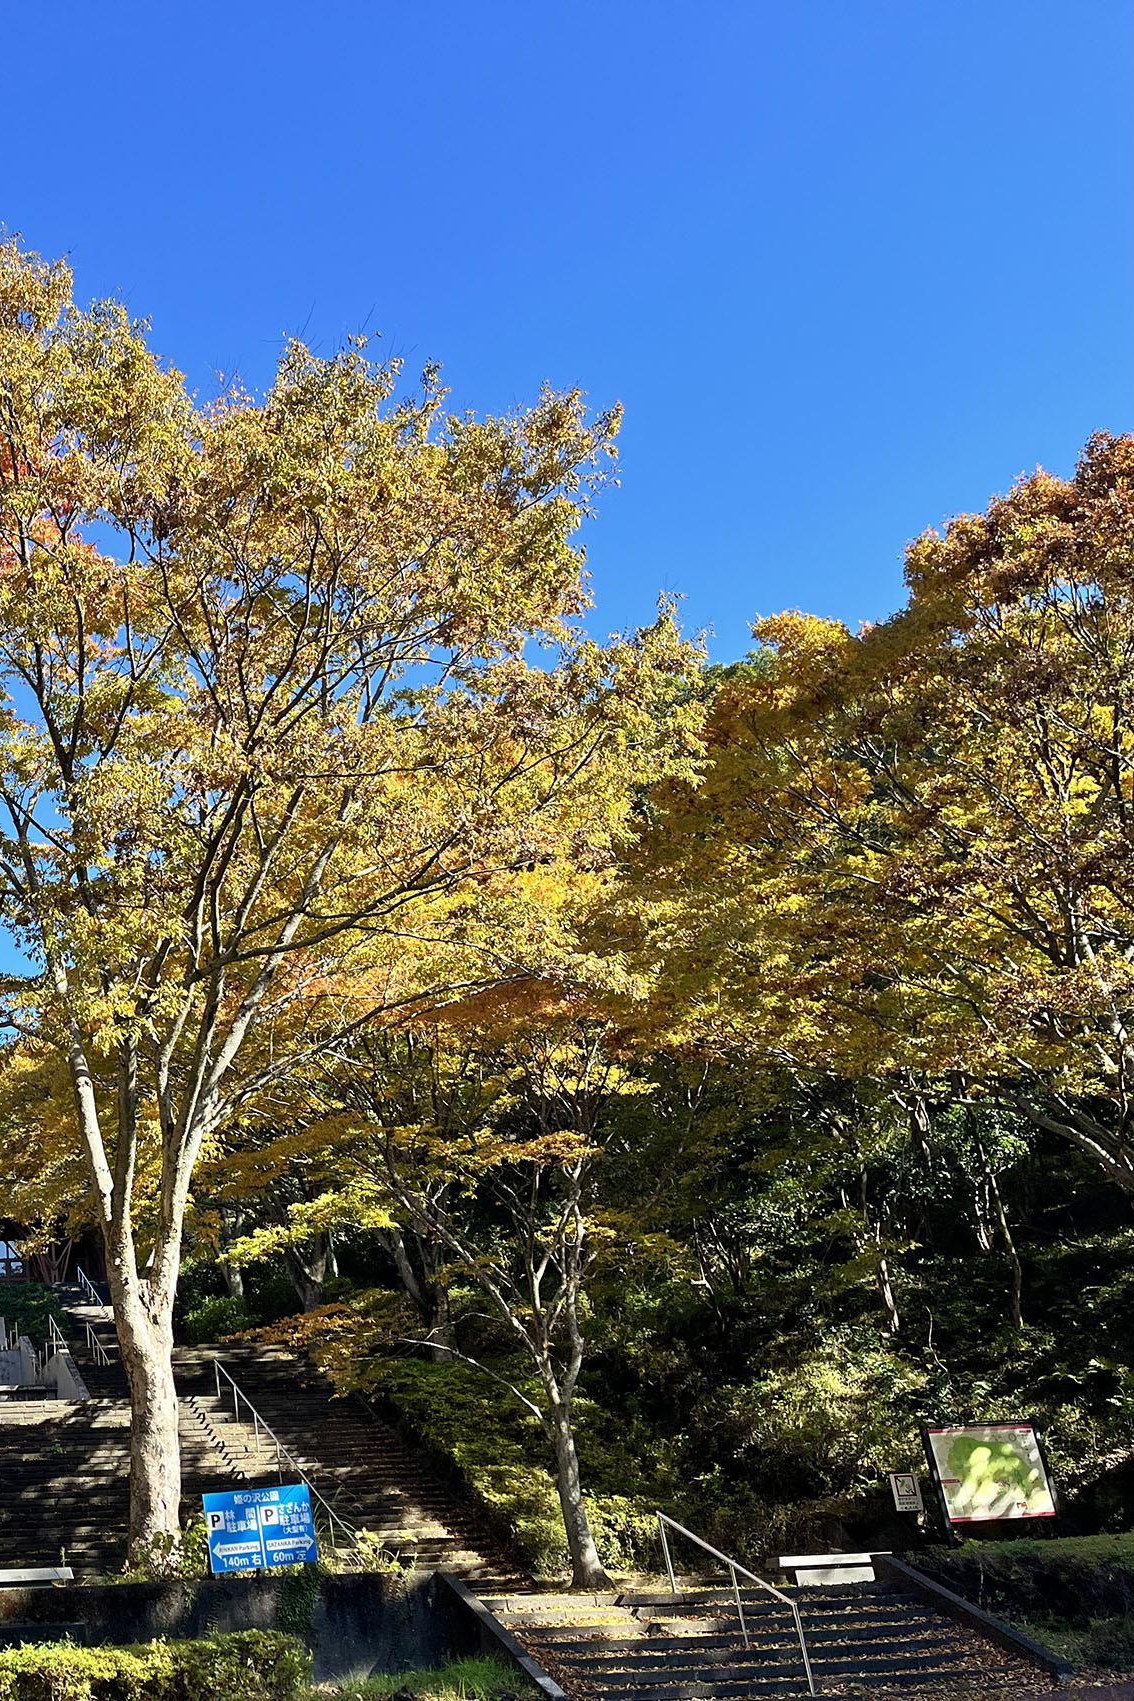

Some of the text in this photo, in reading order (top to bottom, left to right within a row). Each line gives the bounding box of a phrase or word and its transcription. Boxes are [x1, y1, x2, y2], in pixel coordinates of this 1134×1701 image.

[278, 1501, 309, 1514] さざんか
[211, 1514, 221, 1528] P
[264, 1508, 274, 1523] P
[279, 1512, 310, 1526] 駐車場
[226, 1519, 258, 1533] 駐車場
[239, 1543, 258, 1551] Parking
[268, 1538, 311, 1548] SAZANKA Parking
[222, 1553, 262, 1568] 140m 右
[273, 1551, 294, 1562] 60m
